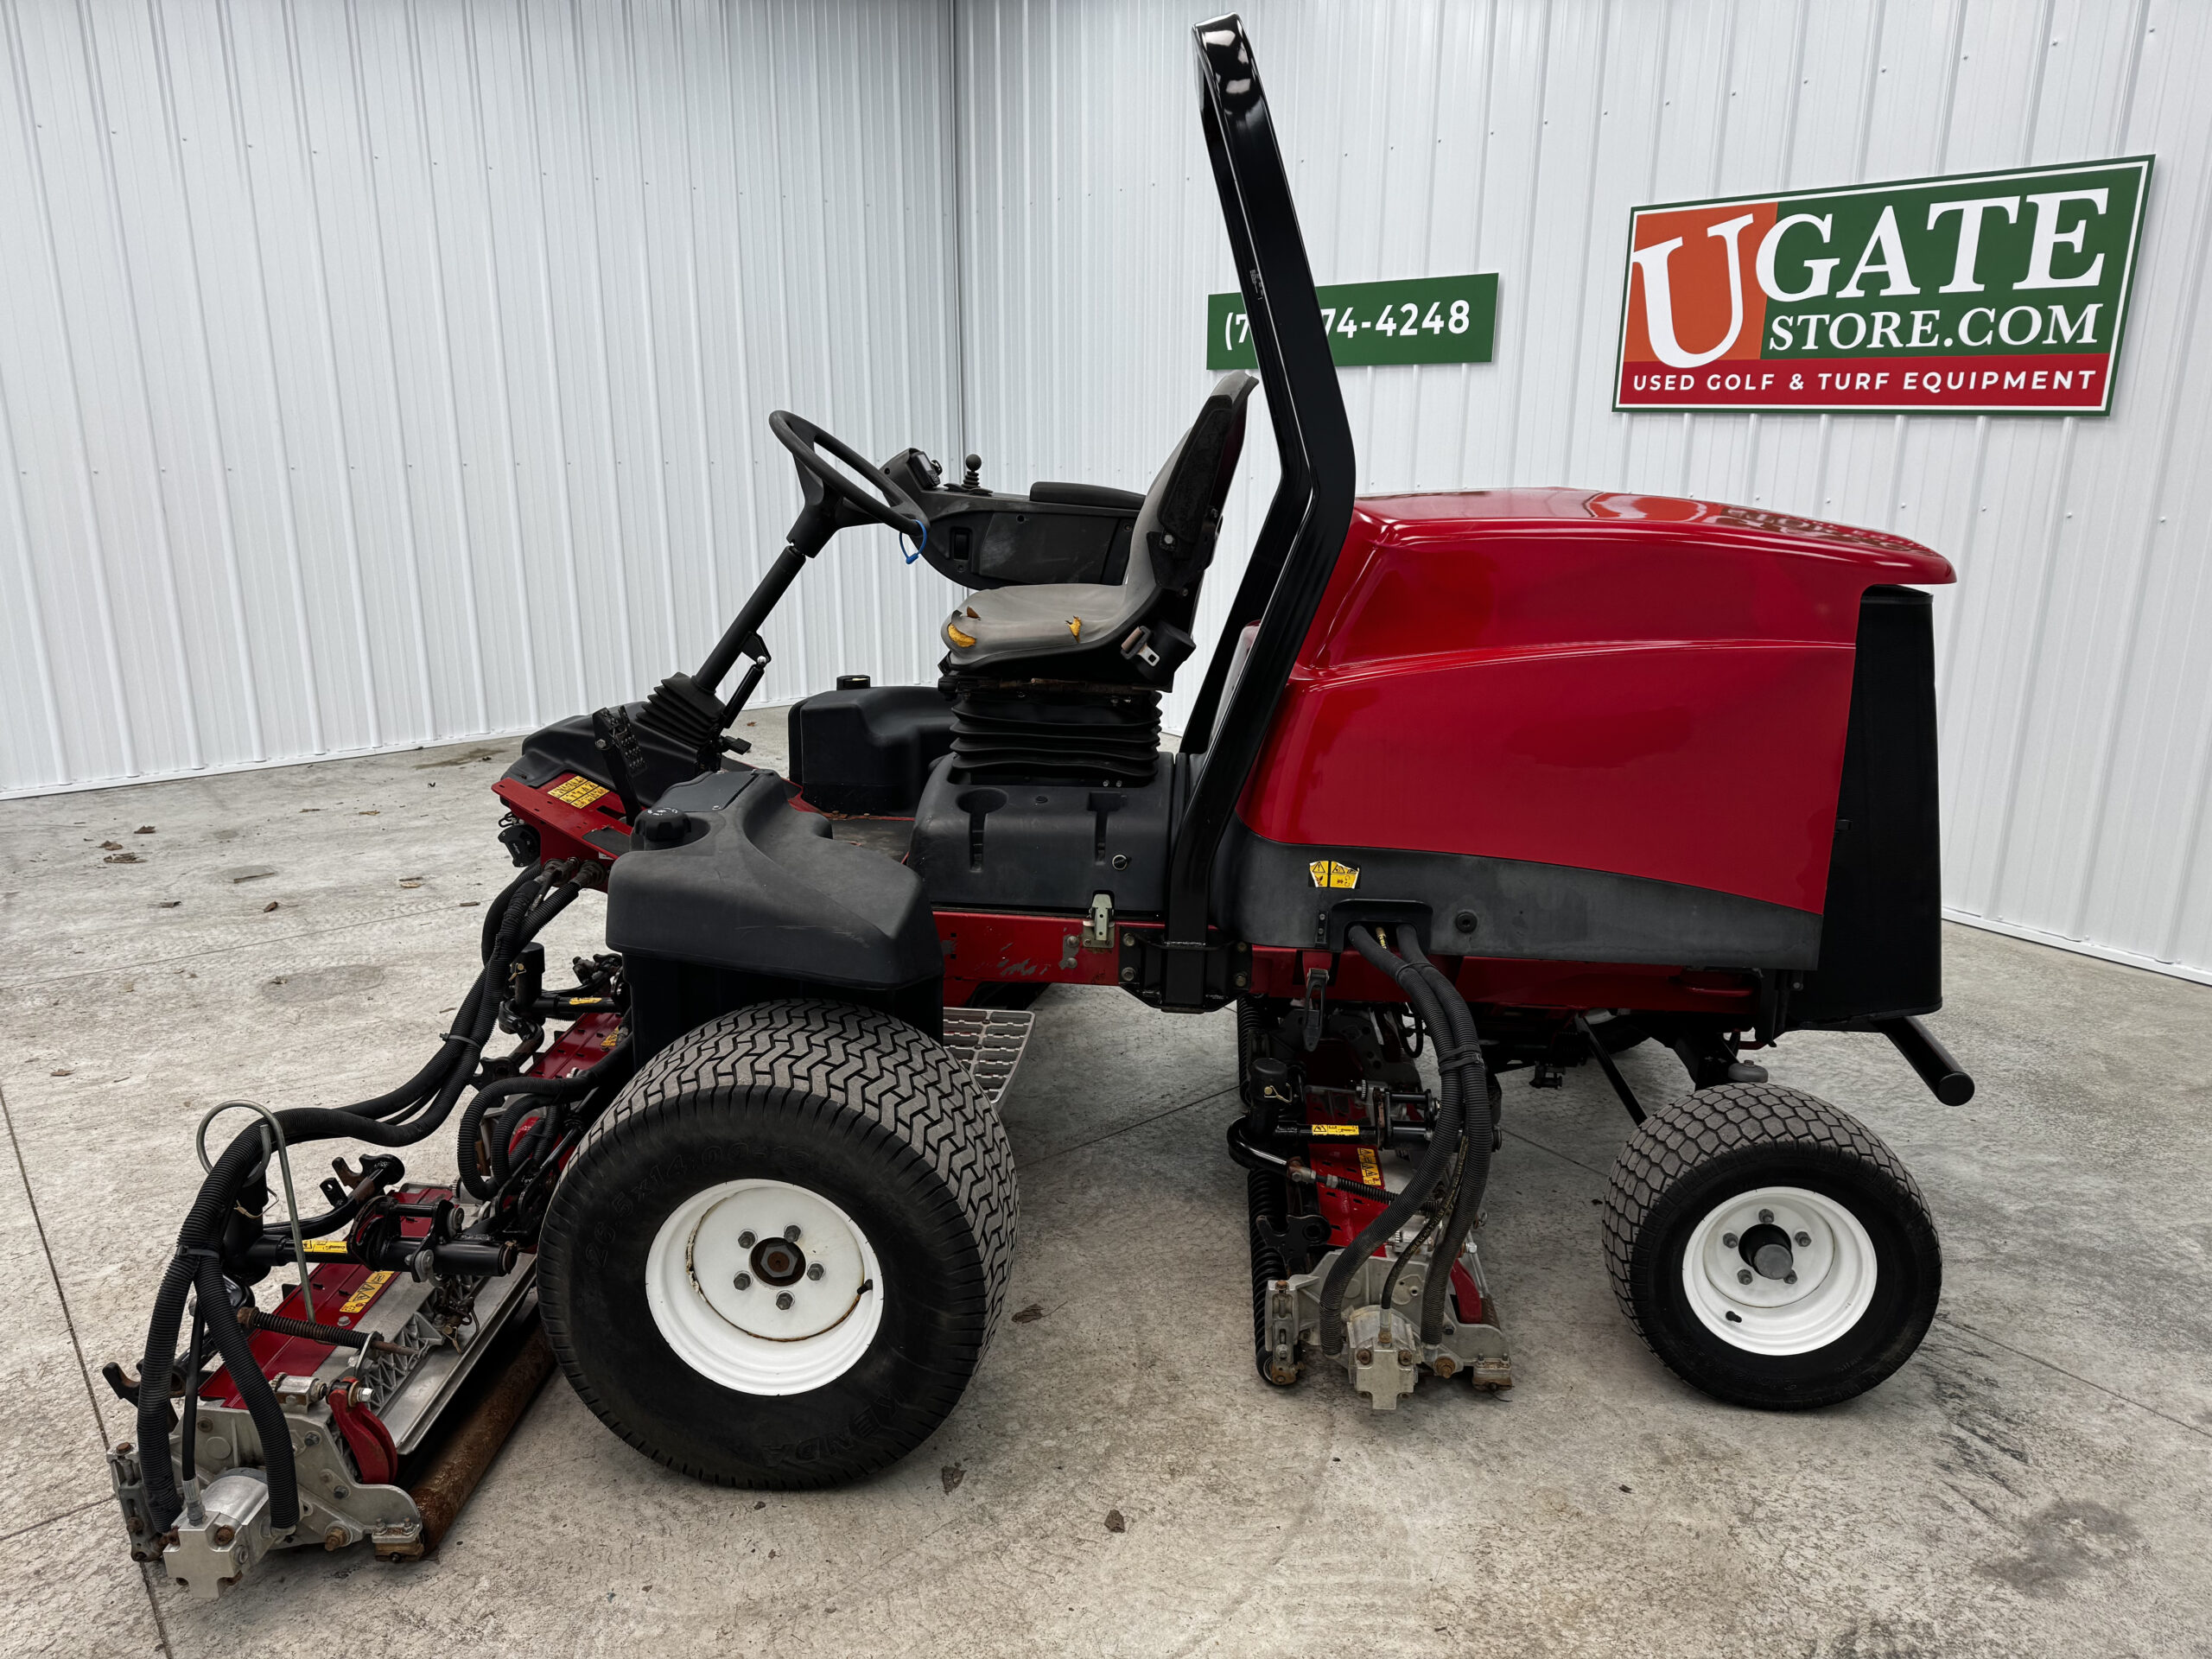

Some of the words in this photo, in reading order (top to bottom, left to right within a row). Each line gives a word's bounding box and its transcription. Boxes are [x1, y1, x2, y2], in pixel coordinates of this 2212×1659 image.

[1320, 299, 1471, 339] 74-4248
[1769, 303, 2103, 351] STORE.COM
[1633, 374, 1695, 391] USED
[1707, 373, 1775, 391] GOLF
[1789, 372, 1804, 391] &
[1817, 372, 1891, 391] TURF
[1903, 370, 2096, 392] EQUIPMENT
